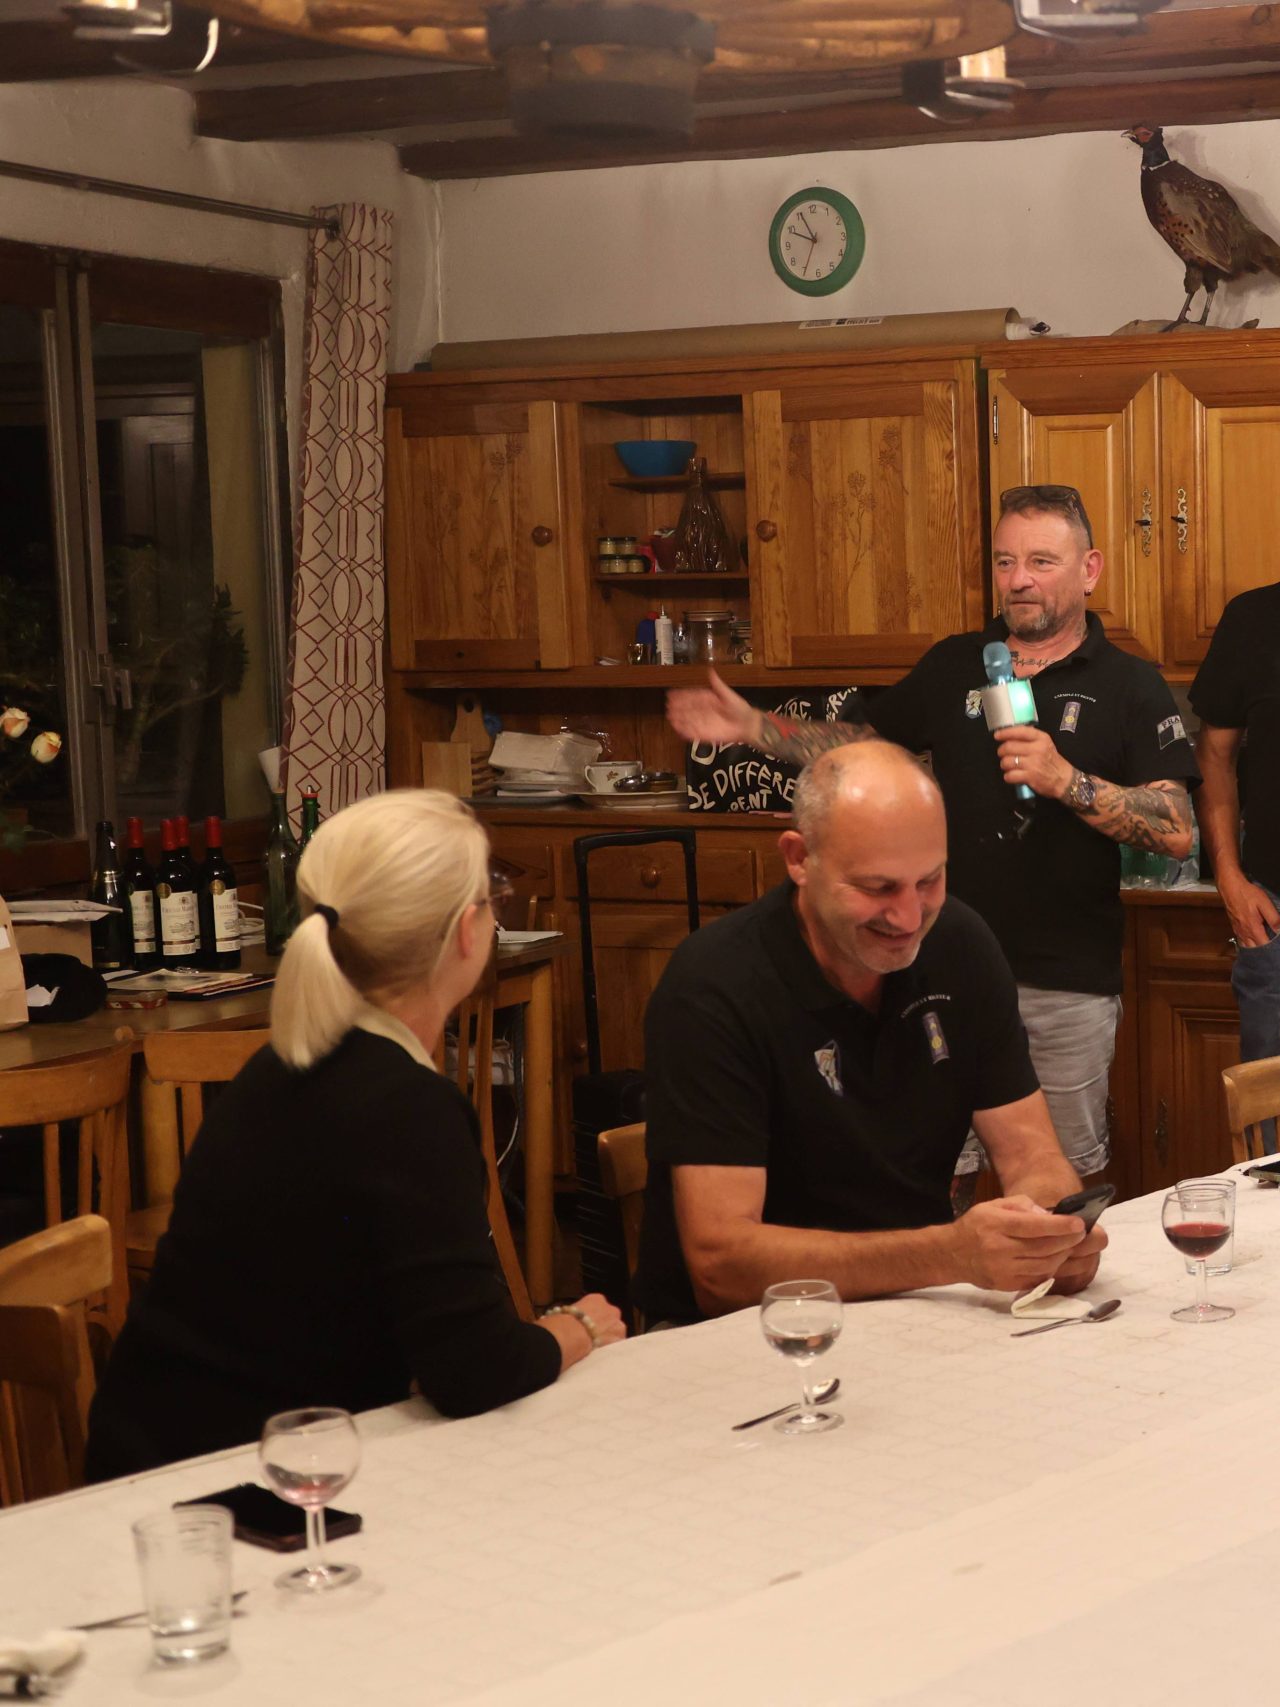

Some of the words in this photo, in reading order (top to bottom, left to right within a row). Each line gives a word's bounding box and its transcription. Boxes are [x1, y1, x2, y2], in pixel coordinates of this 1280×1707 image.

[808, 204, 817, 214] 12
[825, 207, 829, 216] 1
[835, 216, 841, 226] 2
[787, 225, 796, 234] 10
[840, 232, 846, 241] 3
[785, 241, 791, 251] 9
[838, 248, 844, 257] 4
[790, 257, 796, 266] 8
[829, 262, 835, 271] 5
[815, 269, 821, 278] 6
[1161, 716, 1180, 729] FRA
[712, 760, 797, 803] DIFFERE
